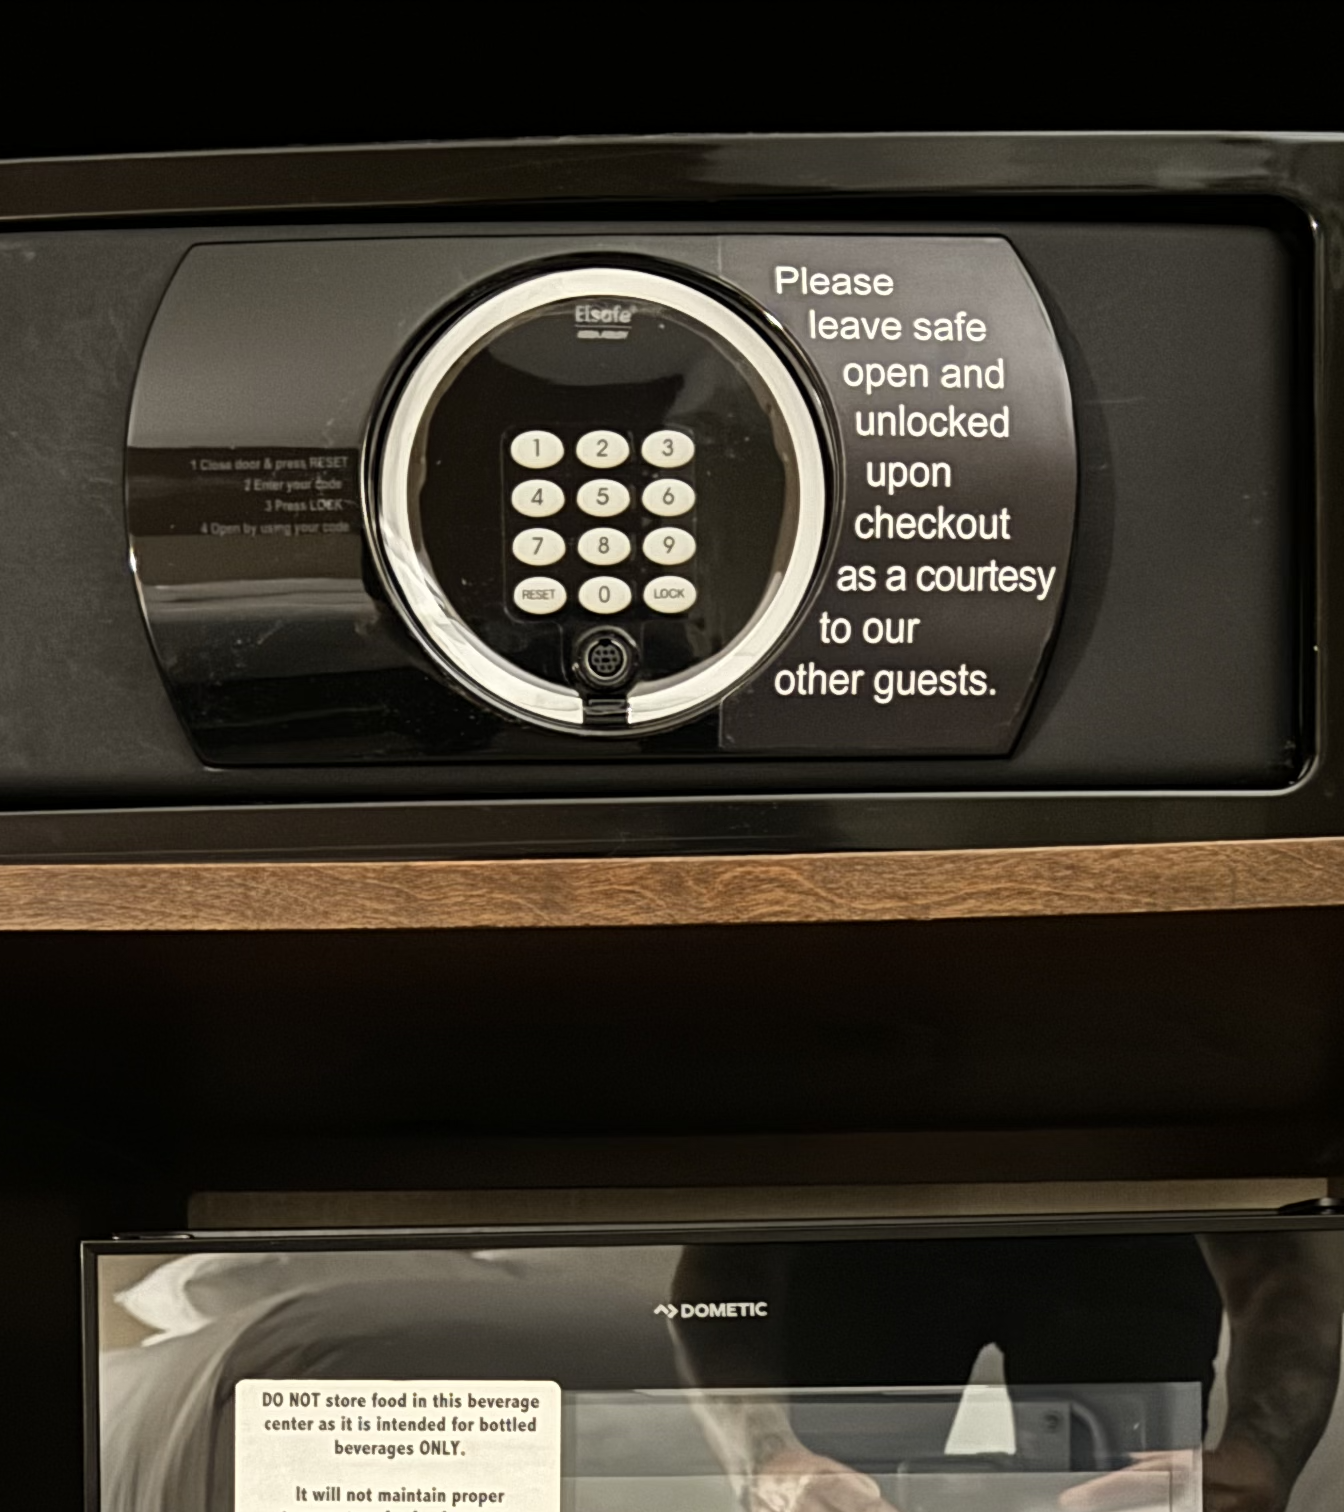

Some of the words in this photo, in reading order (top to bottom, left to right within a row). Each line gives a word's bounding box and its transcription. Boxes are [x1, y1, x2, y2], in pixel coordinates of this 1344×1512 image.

[774, 266, 894, 296] Please
[808, 310, 902, 340] leave
[913, 312, 987, 341] safe
[843, 361, 929, 394] open
[940, 358, 1005, 390] and
[855, 405, 1010, 438] unlocked
[533, 439, 540, 457] 1
[596, 439, 608, 457] 2
[662, 439, 674, 457] 3
[309, 456, 348, 468] RESET
[867, 460, 951, 494] upon
[531, 488, 543, 506] 4
[596, 488, 608, 505] 5
[663, 487, 675, 505] 6
[854, 506, 1011, 540] checkout
[532, 537, 544, 555] 7
[597, 537, 610, 555] 8
[663, 536, 675, 554] 9
[837, 565, 876, 592] as
[886, 565, 906, 592] a
[916, 559, 1056, 600] courtesy
[522, 589, 555, 600] RESET
[598, 586, 610, 603] 0
[653, 588, 685, 599] LOCK
[820, 611, 851, 644] to
[862, 616, 920, 644] our
[774, 663, 865, 696] other
[873, 665, 997, 704] guests.
[680, 1302, 768, 1318] DOMETIC
[262, 1392, 283, 1407] DO
[289, 1393, 320, 1407] NOT
[326, 1394, 366, 1408] store
[372, 1393, 407, 1408] food
[413, 1393, 427, 1408] in
[433, 1393, 462, 1408] this
[468, 1393, 540, 1412] beverage
[264, 1418, 314, 1431] center
[318, 1419, 335, 1431] as
[341, 1417, 352, 1431] it
[358, 1417, 371, 1431] is
[377, 1417, 446, 1432] intended
[452, 1417, 474, 1432] for
[479, 1418, 537, 1432] bottled
[334, 1440, 414, 1459] beverages
[419, 1441, 466, 1456] ONLY.
[296, 1487, 307, 1501] It
[313, 1487, 340, 1502] will
[347, 1488, 372, 1502] not
[378, 1487, 446, 1502] maintain
[452, 1490, 504, 1507] proper
